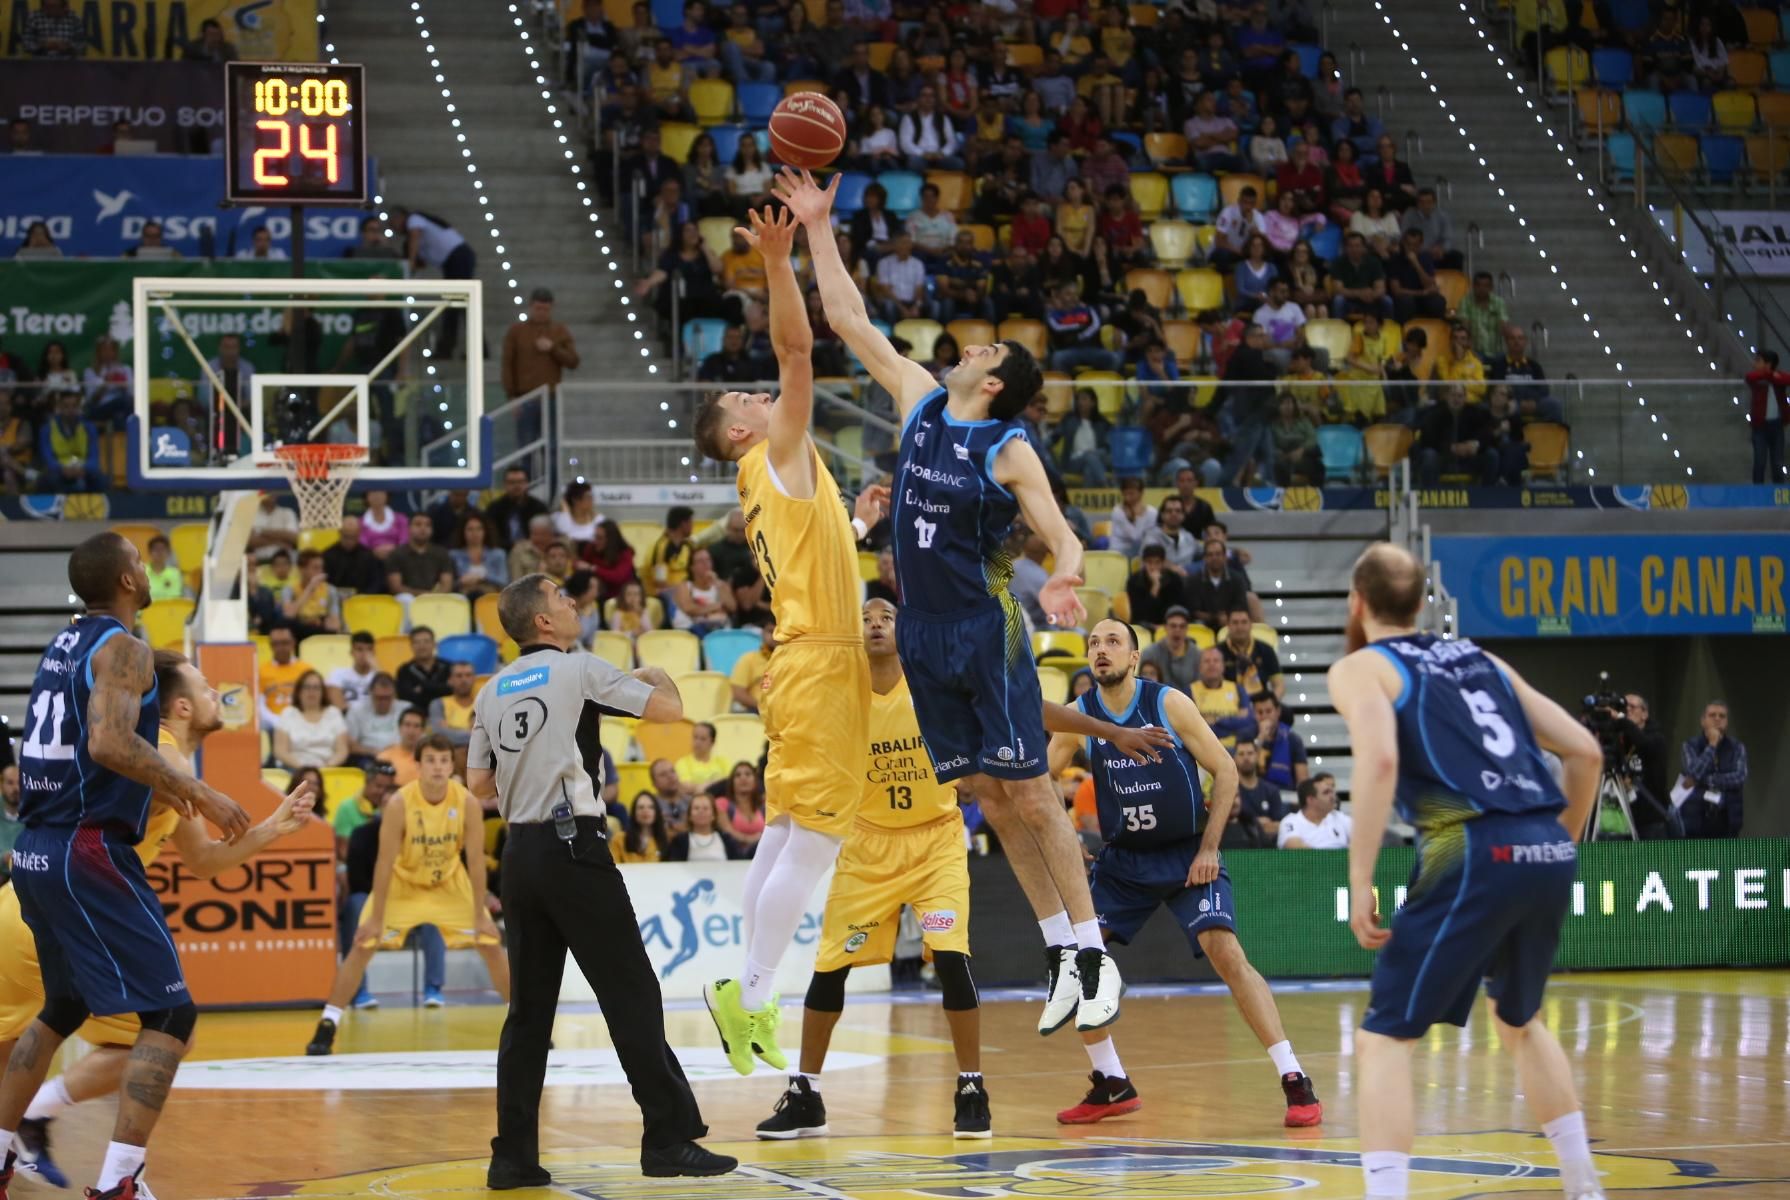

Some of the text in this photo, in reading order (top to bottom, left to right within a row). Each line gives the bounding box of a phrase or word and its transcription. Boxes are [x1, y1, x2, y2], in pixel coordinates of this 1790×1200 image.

[255, 78, 347, 116] 10:00
[19, 104, 166, 127] PERPETUO
[253, 120, 338, 185] 24
[10, 306, 86, 335] Teror
[1501, 557, 1618, 617] GRAN
[23, 689, 75, 760] 11
[515, 711, 528, 739] 3
[1460, 687, 1515, 758] 5
[867, 768, 928, 784] Canaria
[874, 756, 914, 770] Gran
[886, 785, 912, 810] 13
[1122, 804, 1157, 832] 35
[161, 898, 332, 933] ZONE
